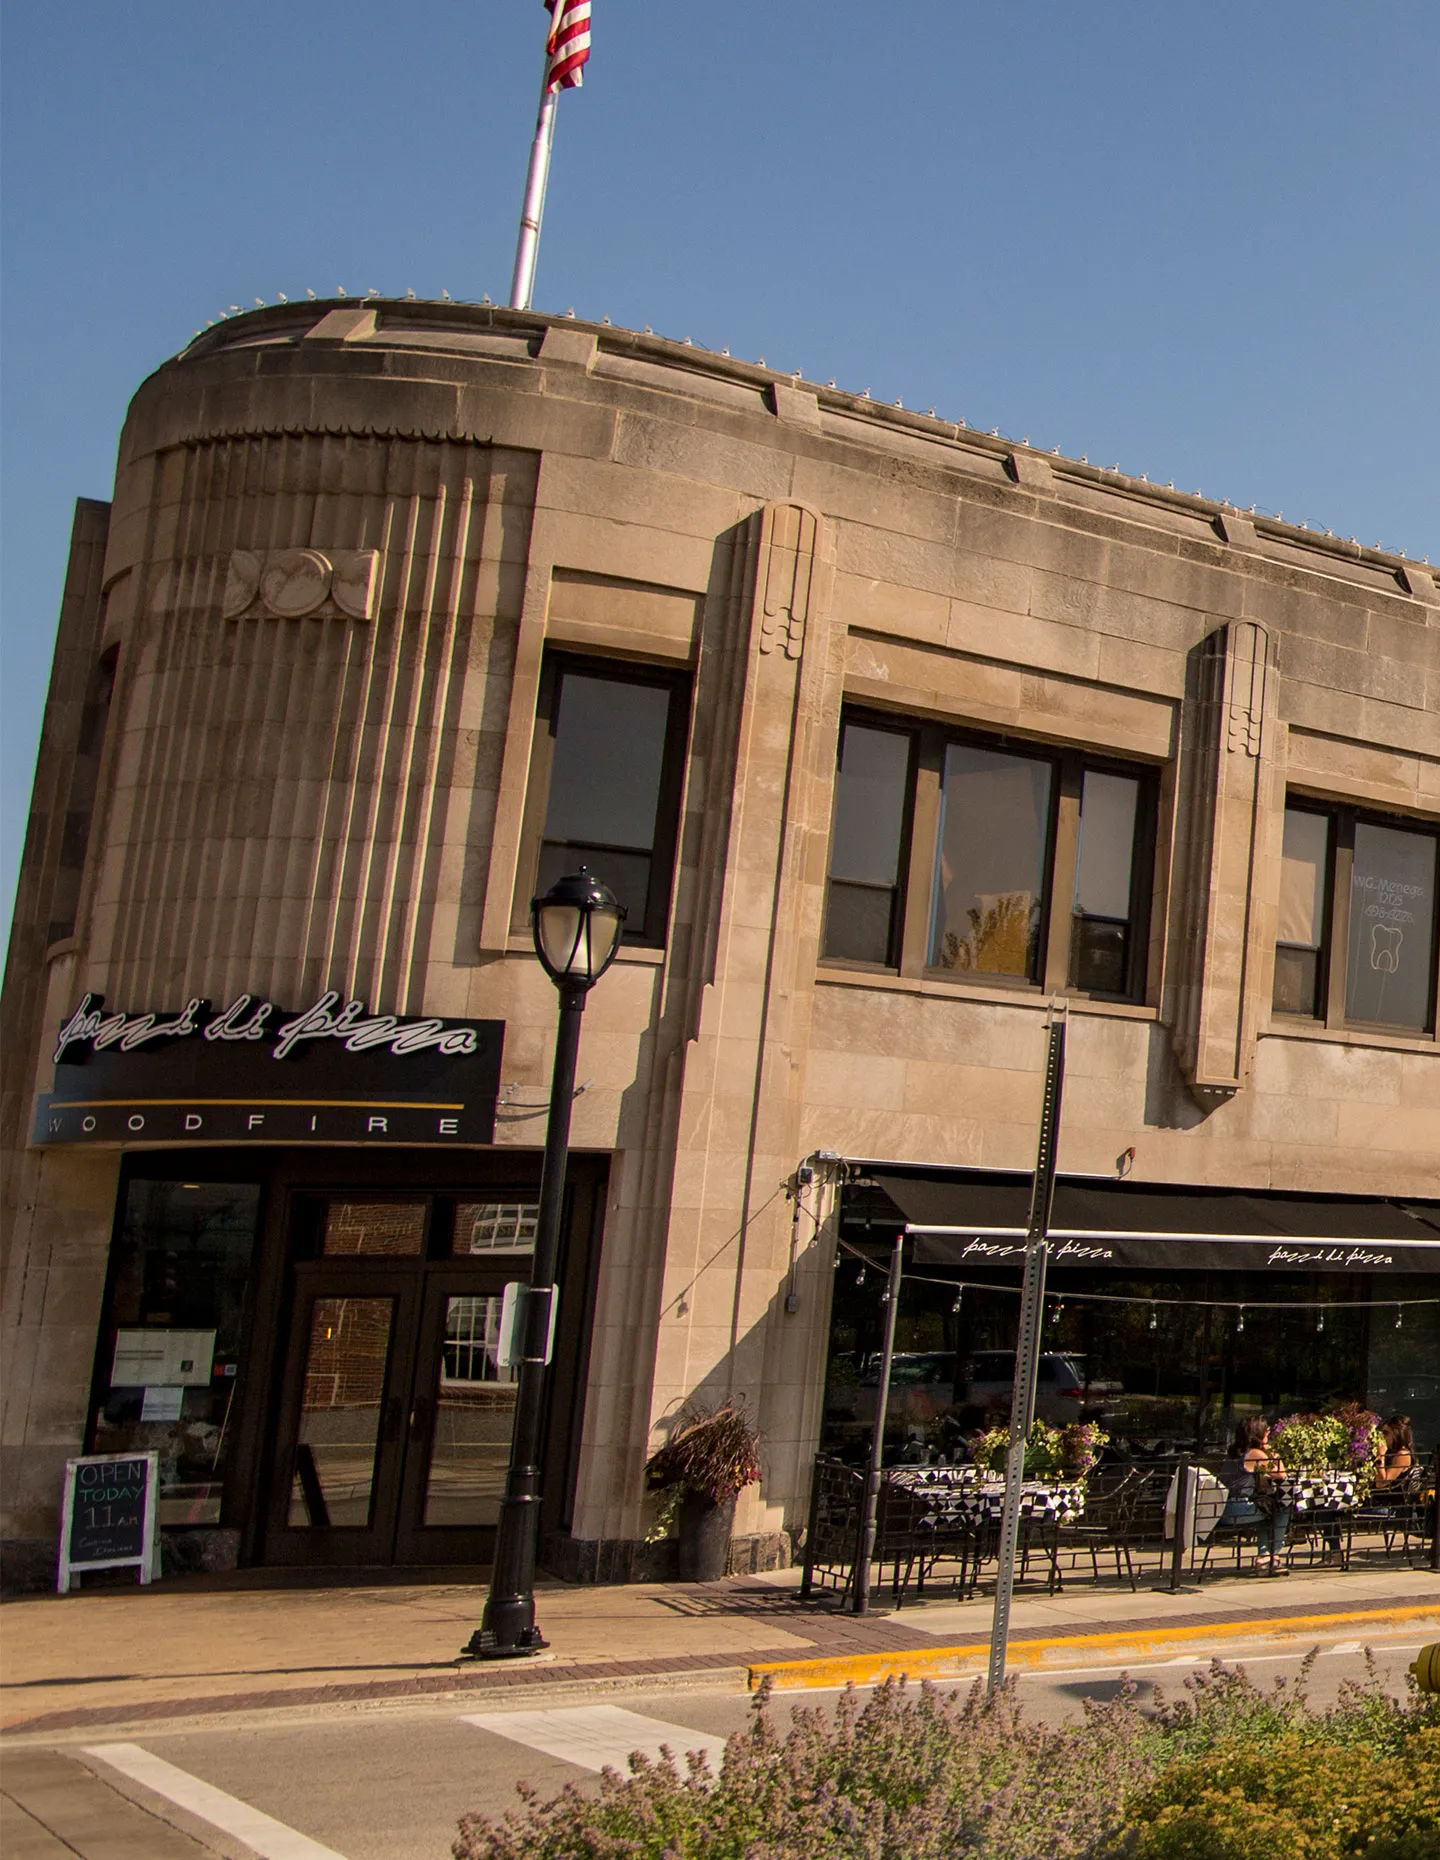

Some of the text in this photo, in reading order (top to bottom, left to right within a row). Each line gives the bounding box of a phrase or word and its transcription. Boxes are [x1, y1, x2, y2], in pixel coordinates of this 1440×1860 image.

[53, 991, 478, 1064] pazzi di pizza
[47, 1113, 459, 1135] WOODFIRE
[1056, 1239, 1113, 1260] pizza
[1267, 1245, 1324, 1265] pazzi
[1344, 1247, 1393, 1266] pizza
[80, 1462, 141, 1485] OPEN
[79, 1485, 145, 1503] TODAY
[83, 1505, 115, 1530] 11
